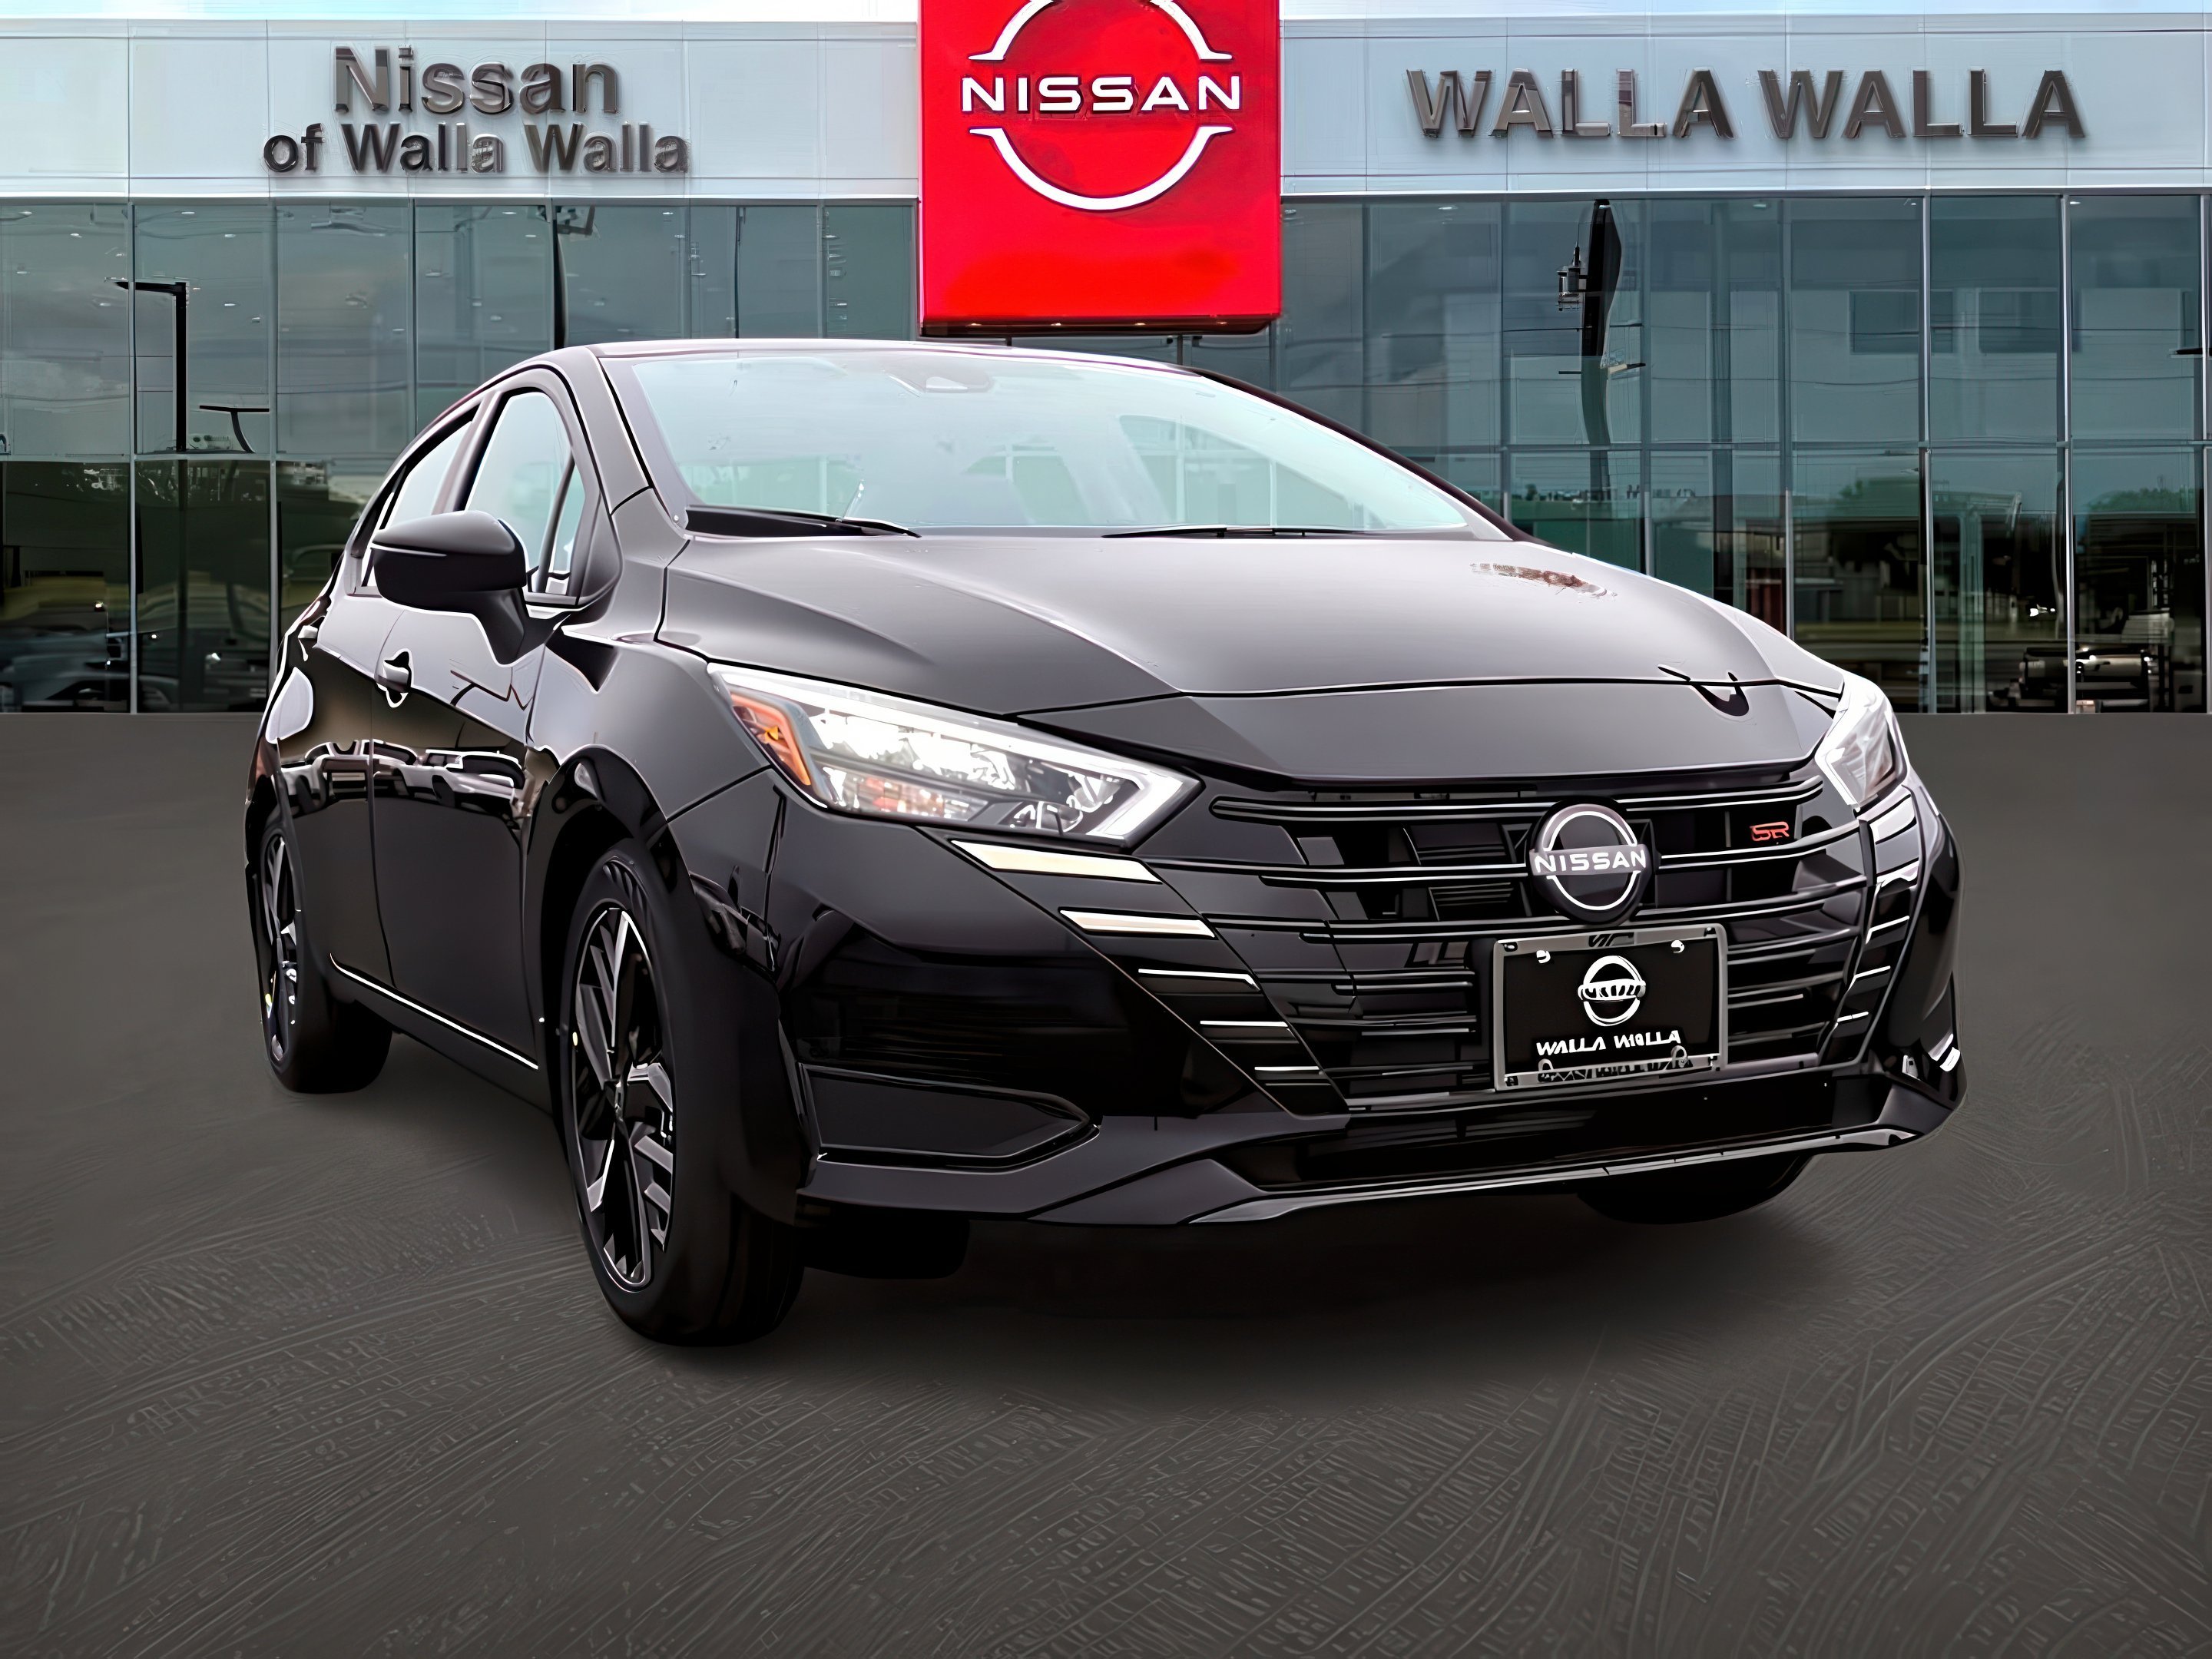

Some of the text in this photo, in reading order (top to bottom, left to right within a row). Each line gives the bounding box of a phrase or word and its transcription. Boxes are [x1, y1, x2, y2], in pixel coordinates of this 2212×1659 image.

[335, 45, 621, 113] Nissan
[962, 75, 1240, 112] NISSAN
[1406, 68, 2086, 139] WALLA WALLA
[263, 122, 689, 174] of Walla Walla
[1750, 821, 1790, 842] SR
[1534, 849, 1647, 873] NISSAN
[1536, 1036, 1606, 1056] WALLA
